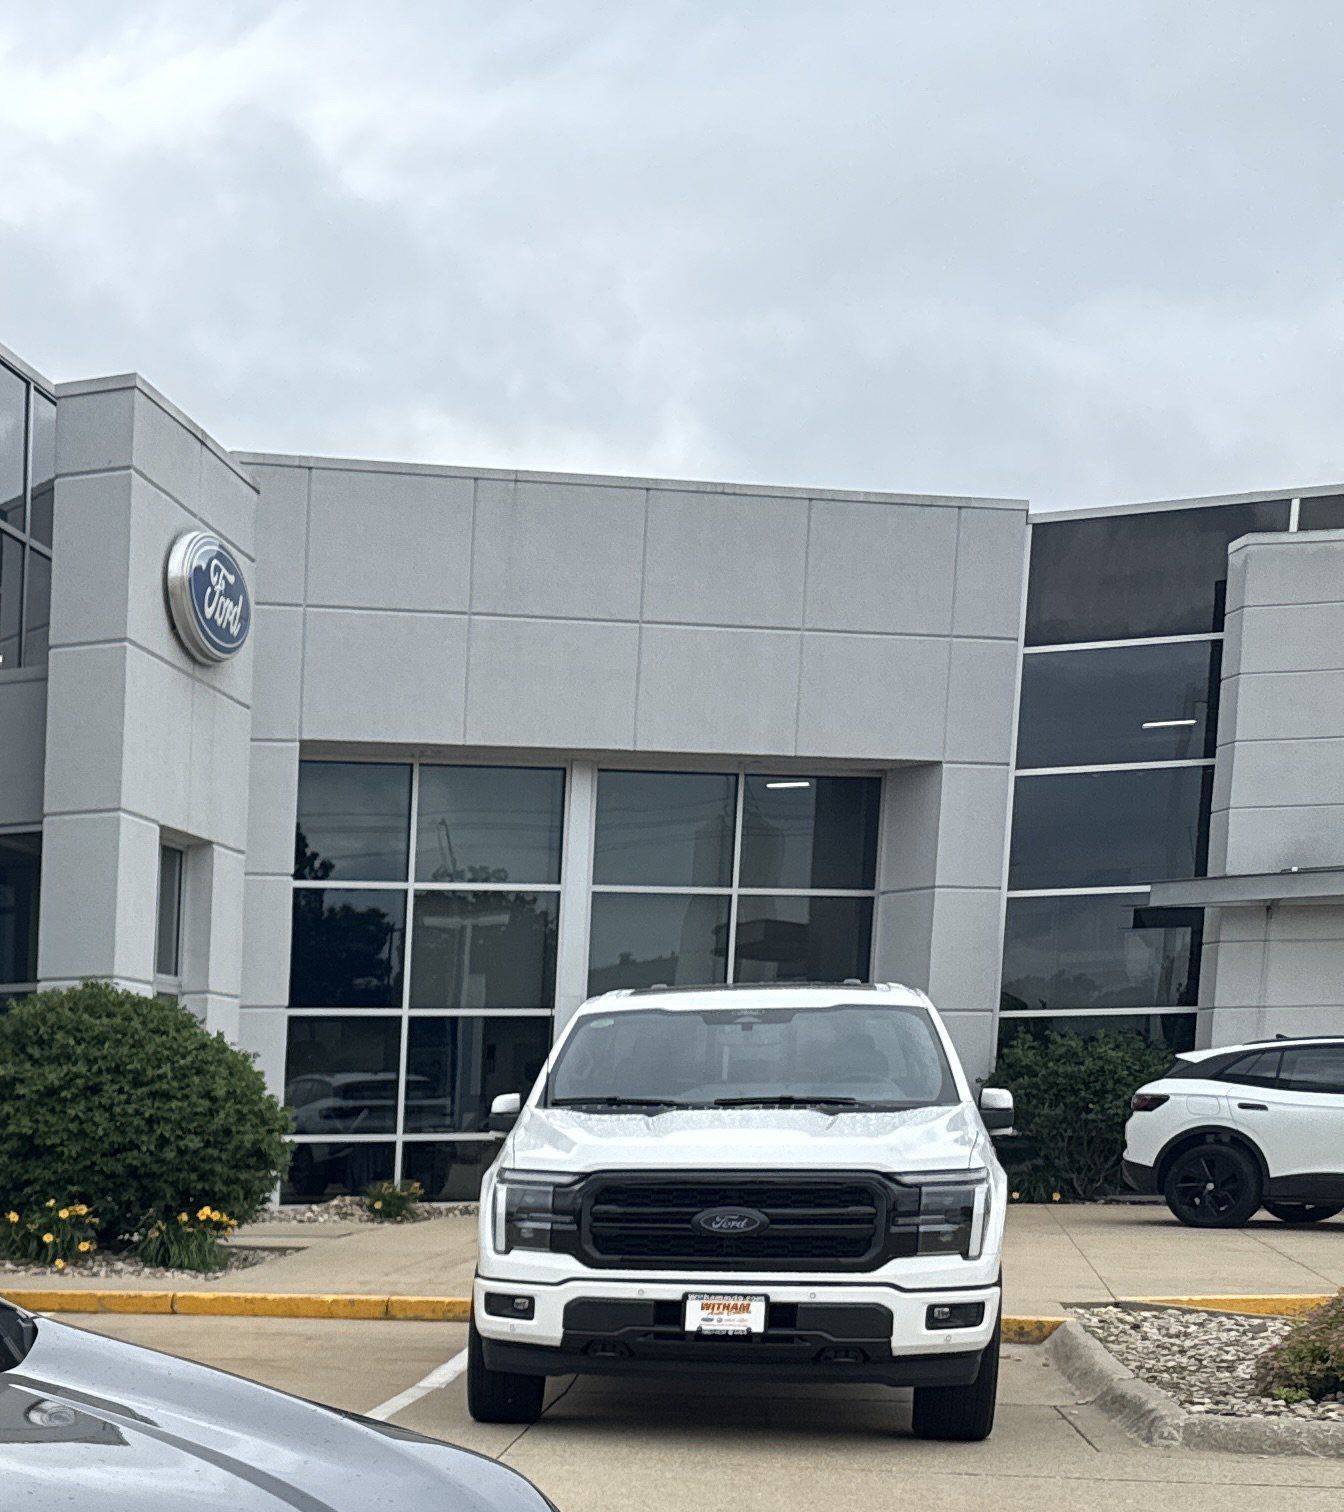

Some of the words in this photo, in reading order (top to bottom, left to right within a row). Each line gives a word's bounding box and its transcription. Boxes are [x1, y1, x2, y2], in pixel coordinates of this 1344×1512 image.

[204, 558, 243, 638] Ford
[712, 1215, 749, 1229] Ford
[700, 1302, 752, 1313] WITHAM
